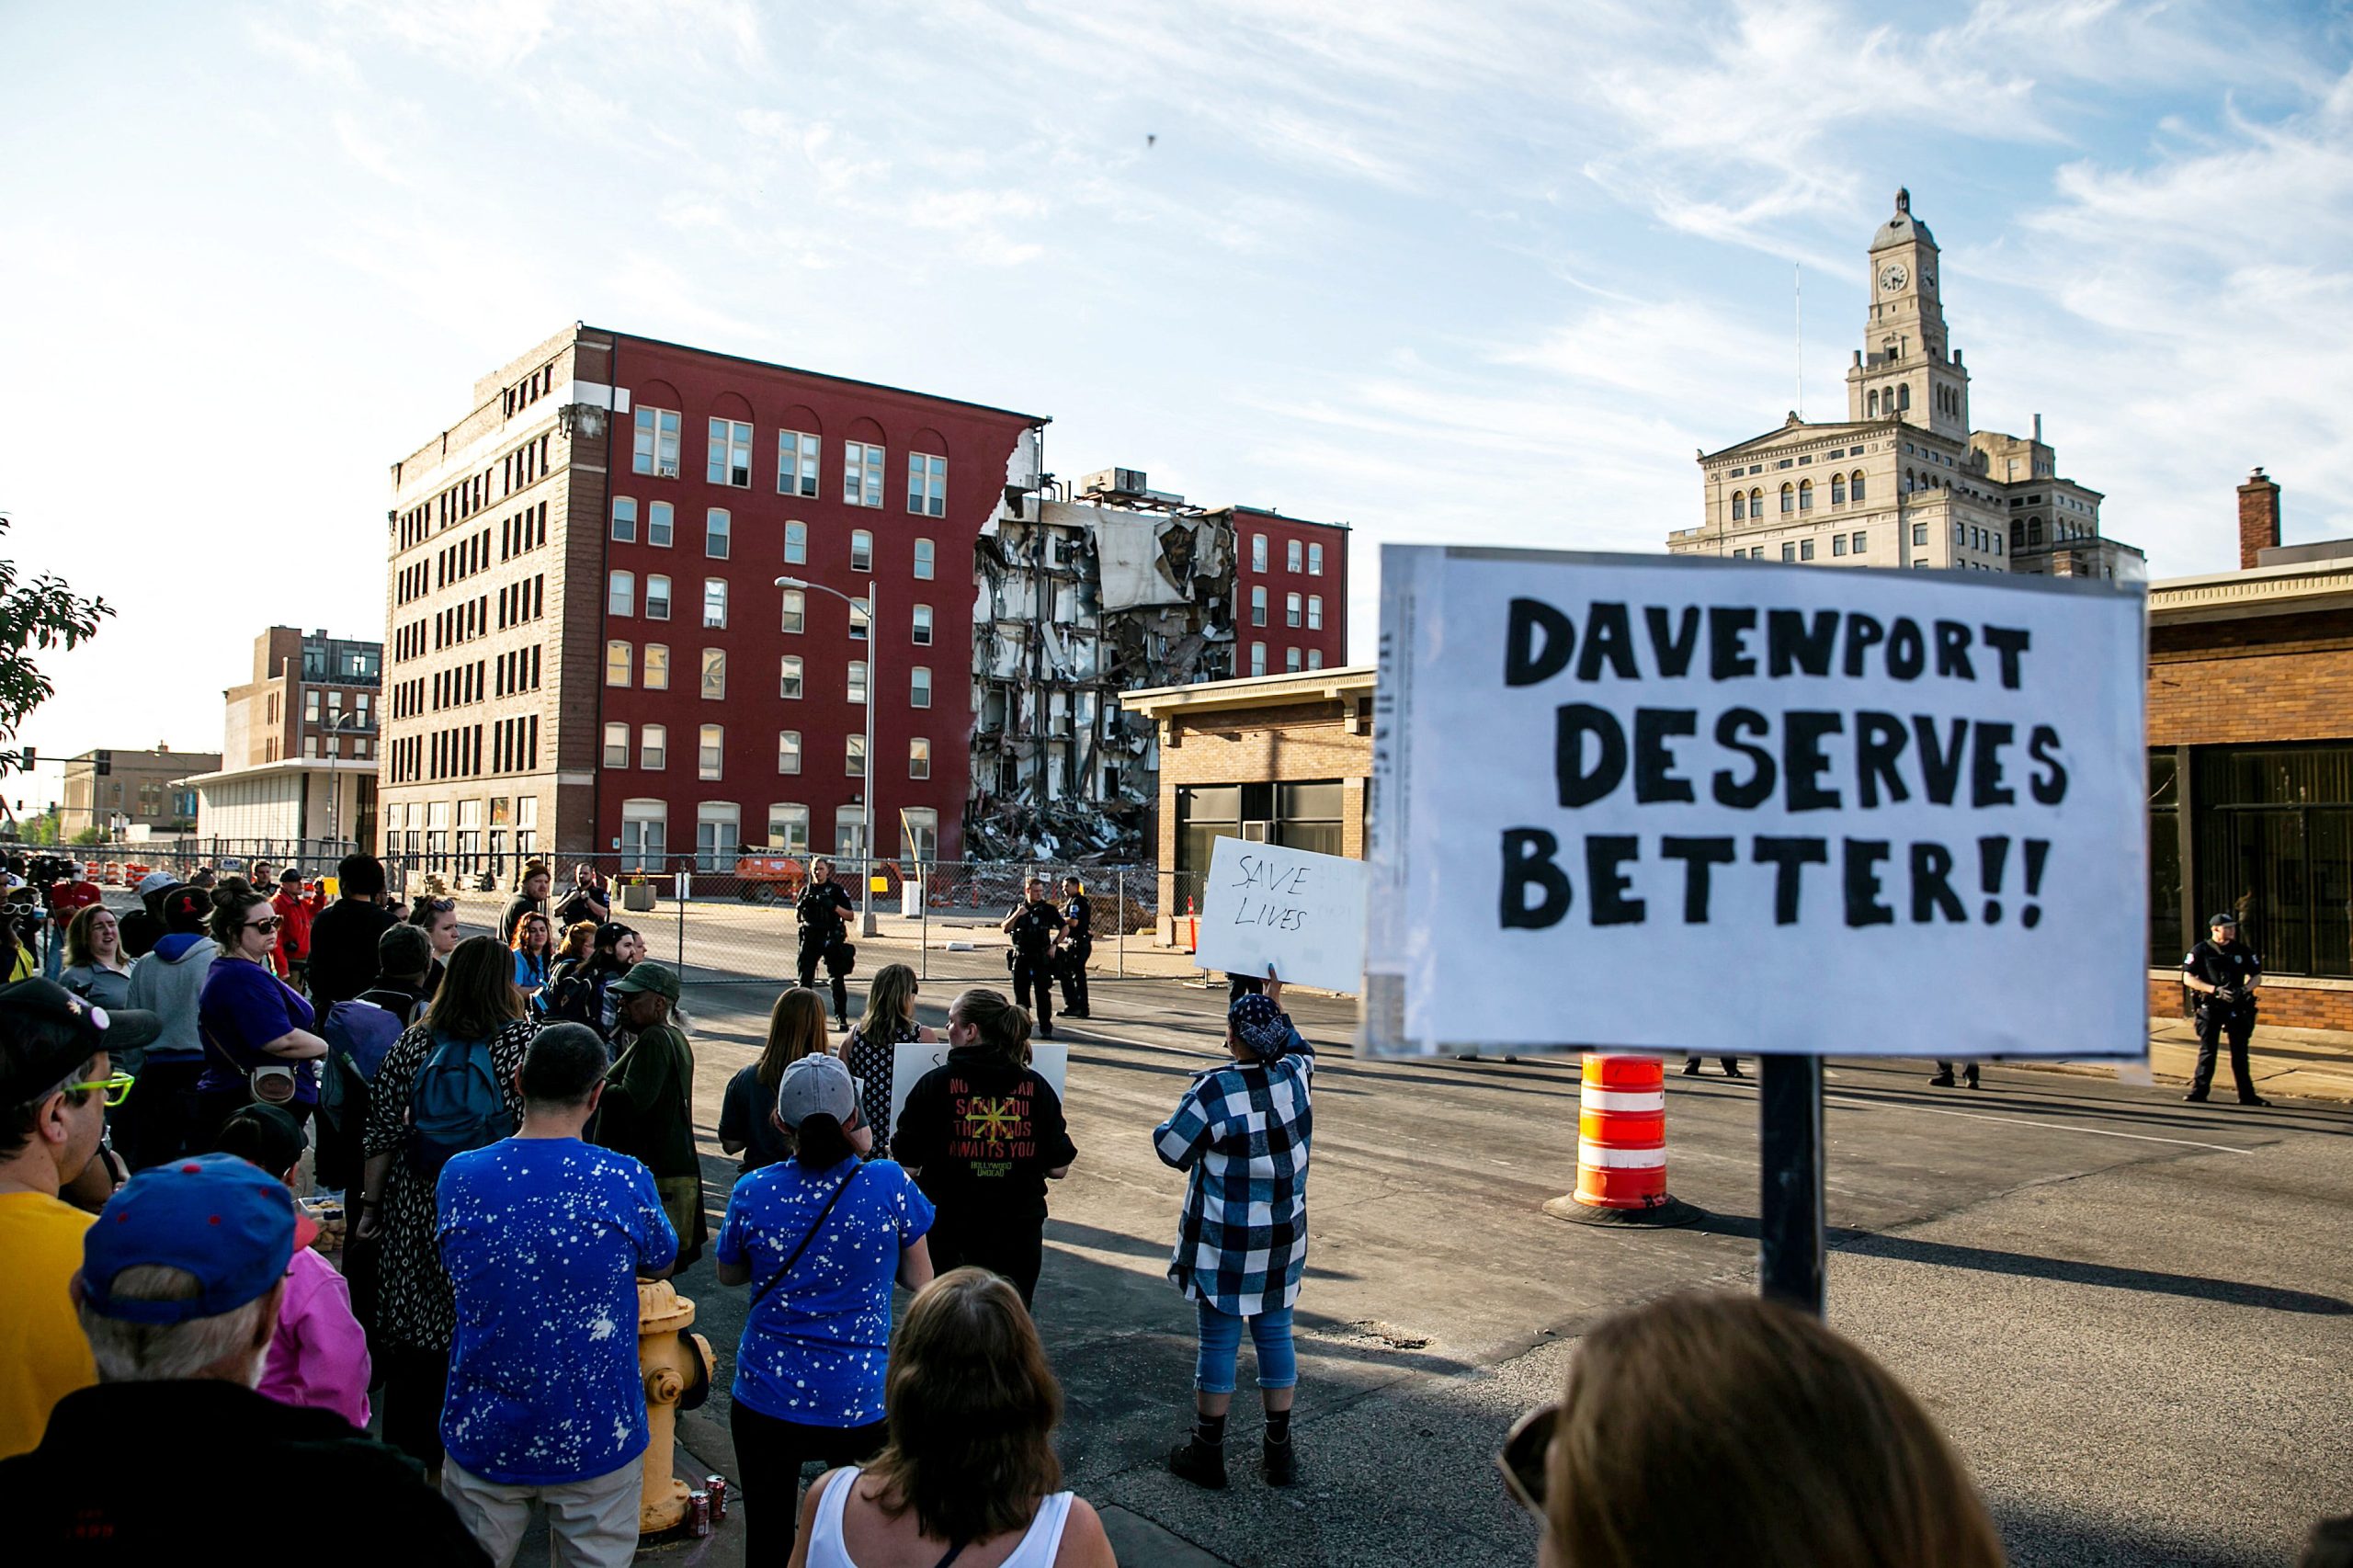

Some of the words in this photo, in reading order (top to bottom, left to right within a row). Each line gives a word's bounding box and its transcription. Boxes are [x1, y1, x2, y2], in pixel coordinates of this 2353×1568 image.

[1505, 597, 2030, 689] DAVENPORT
[1555, 702, 2067, 811] DESERVES
[1231, 855, 1312, 895] SAVE
[1500, 826, 2051, 931] BETTER!!
[1234, 896, 1308, 931] LIVES
[949, 1078, 968, 1094] NO
[1010, 1082, 1034, 1096] AN
[1003, 1100, 1029, 1116] YOU
[949, 1142, 1005, 1158] AWAITS
[1009, 1142, 1036, 1158] YOU
[971, 1161, 1012, 1170] HOLLYWOOD
[977, 1168, 1005, 1177] UNDEAD
